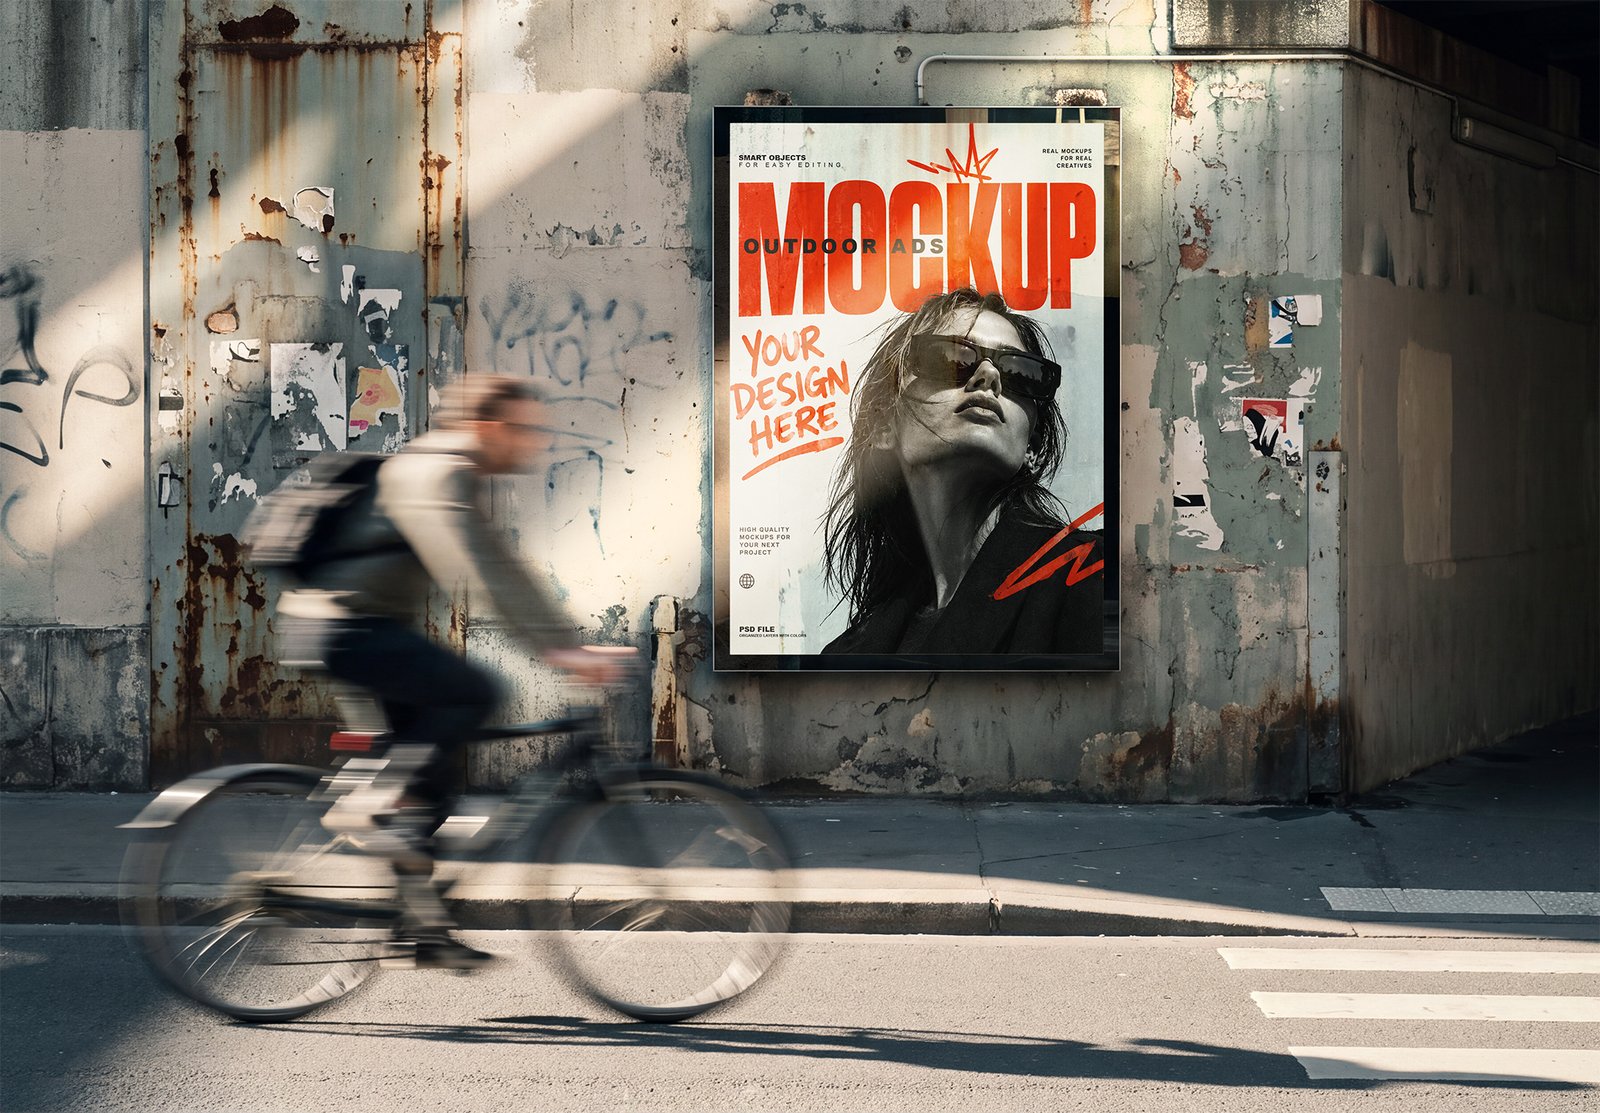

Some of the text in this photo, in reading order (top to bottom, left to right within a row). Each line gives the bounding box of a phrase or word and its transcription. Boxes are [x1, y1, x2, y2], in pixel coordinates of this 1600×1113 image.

[738, 180, 1096, 317] MOCKUP
[743, 238, 944, 254] OUTDOOR ADS
[741, 325, 825, 378] YOUR
[730, 359, 850, 420] DESIGN
[748, 401, 839, 458] HERE
